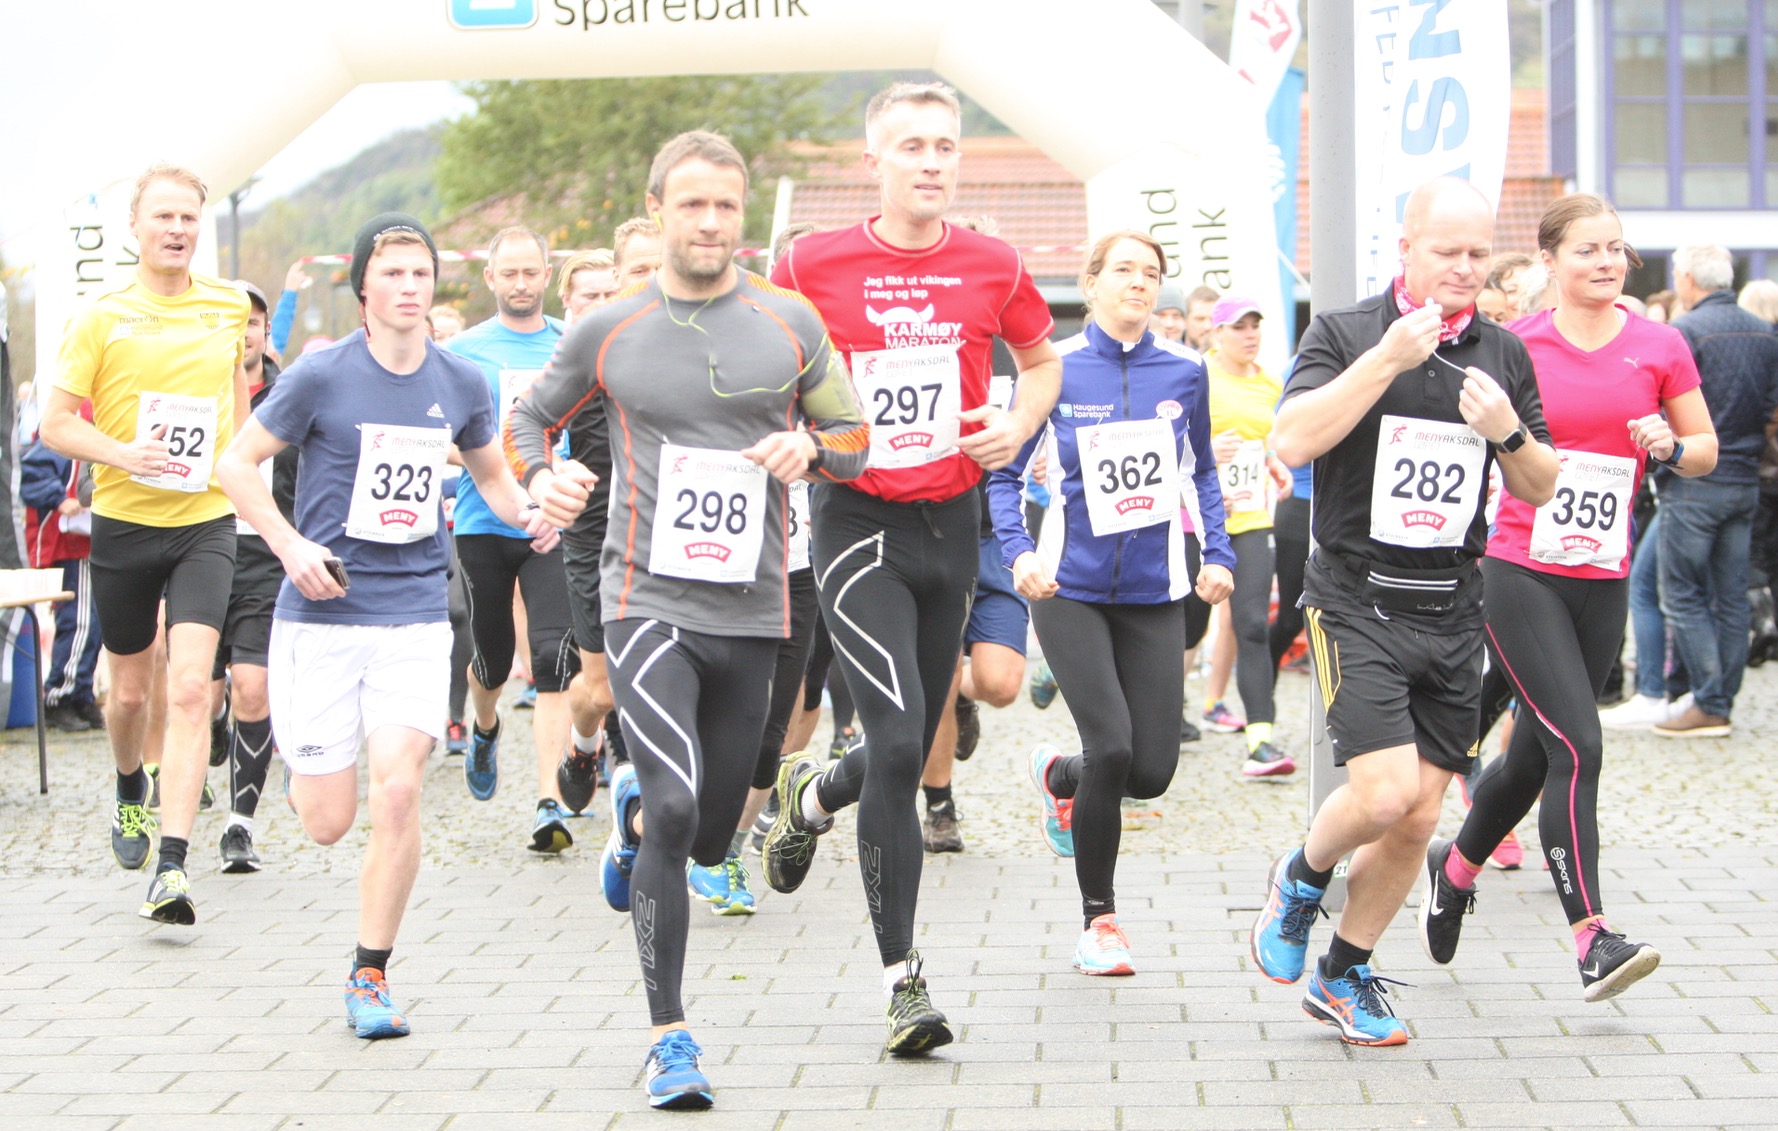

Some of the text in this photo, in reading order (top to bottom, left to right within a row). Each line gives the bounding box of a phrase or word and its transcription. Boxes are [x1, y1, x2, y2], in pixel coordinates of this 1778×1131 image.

[863, 275, 962, 288] Jeg fikk ut vikingen
[870, 289, 893, 300] meg
[895, 289, 908, 300] og
[884, 322, 962, 337] KARMØY
[885, 337, 962, 350] MARATON
[873, 383, 943, 426] 297
[1073, 404, 1114, 412] Haugesund
[893, 435, 930, 447] MENY
[1415, 432, 1480, 447] MENYAKSDAL
[1098, 451, 1162, 494] 362
[1228, 462, 1258, 487] 314
[1576, 462, 1630, 477] MENYAKSDAL
[371, 463, 432, 503] 323
[1390, 457, 1466, 504] 282
[673, 488, 748, 535] 298
[1120, 498, 1152, 511] MENY
[1552, 487, 1617, 531] 359
[383, 511, 415, 524] MENY
[1406, 513, 1443, 527] MENY
[688, 544, 728, 557] MENY
[1564, 538, 1598, 549] MENY
